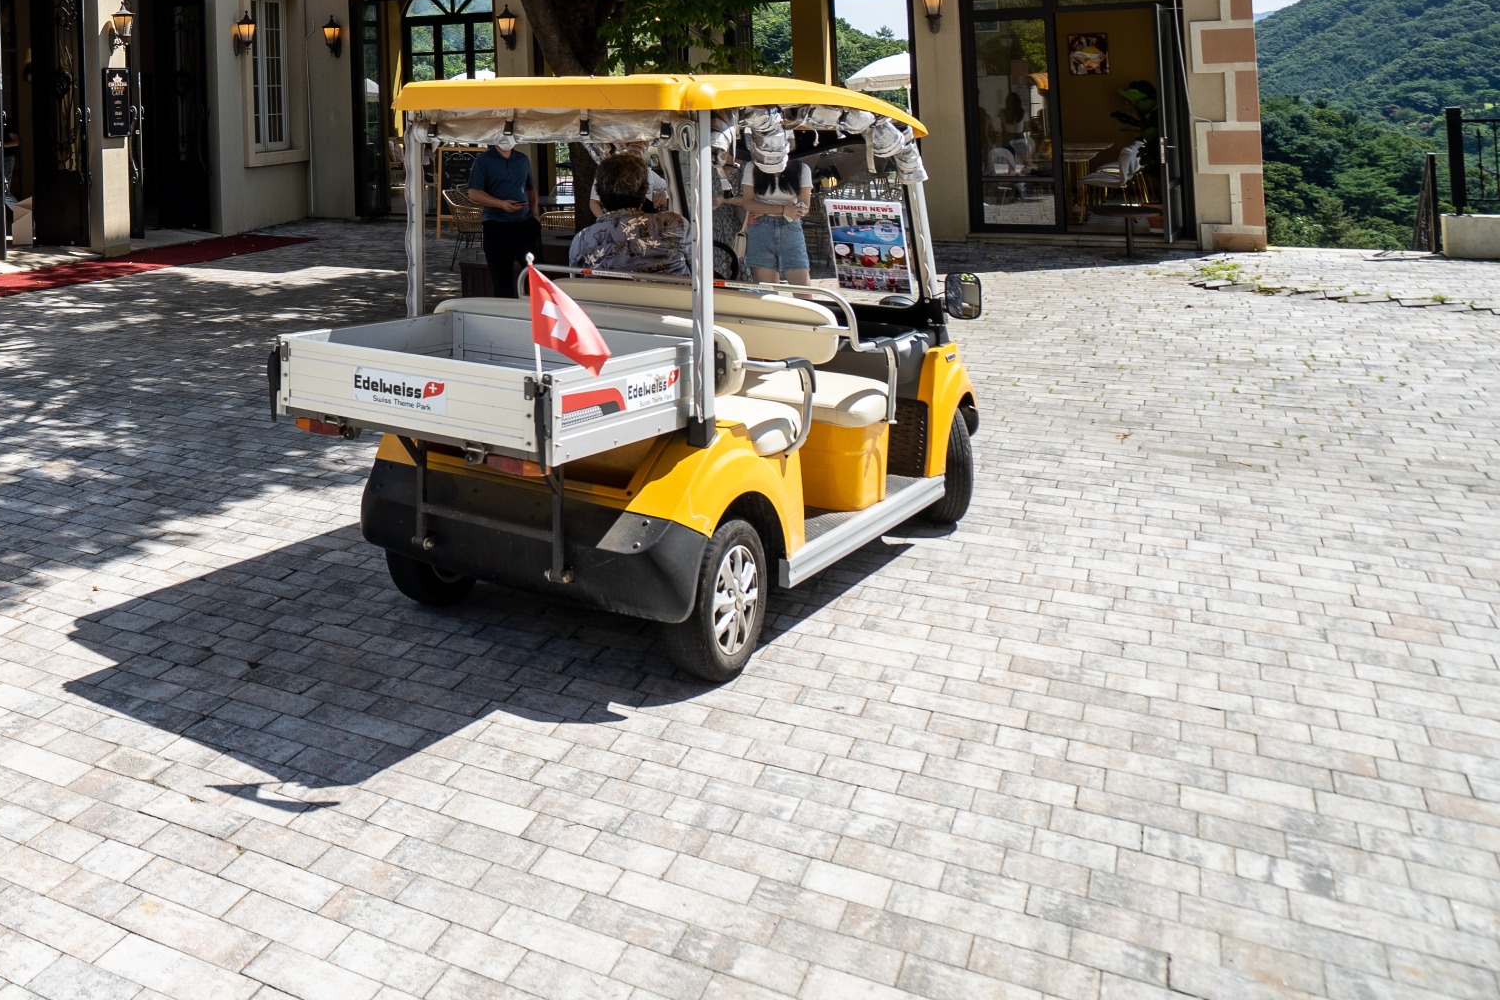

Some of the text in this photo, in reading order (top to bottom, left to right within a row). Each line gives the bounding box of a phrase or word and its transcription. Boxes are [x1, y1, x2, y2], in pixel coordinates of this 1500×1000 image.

[354, 374, 422, 399] Edelweiss
[628, 379, 667, 400] Edelweiss
[372, 394, 431, 411] Swiss Theme Park
